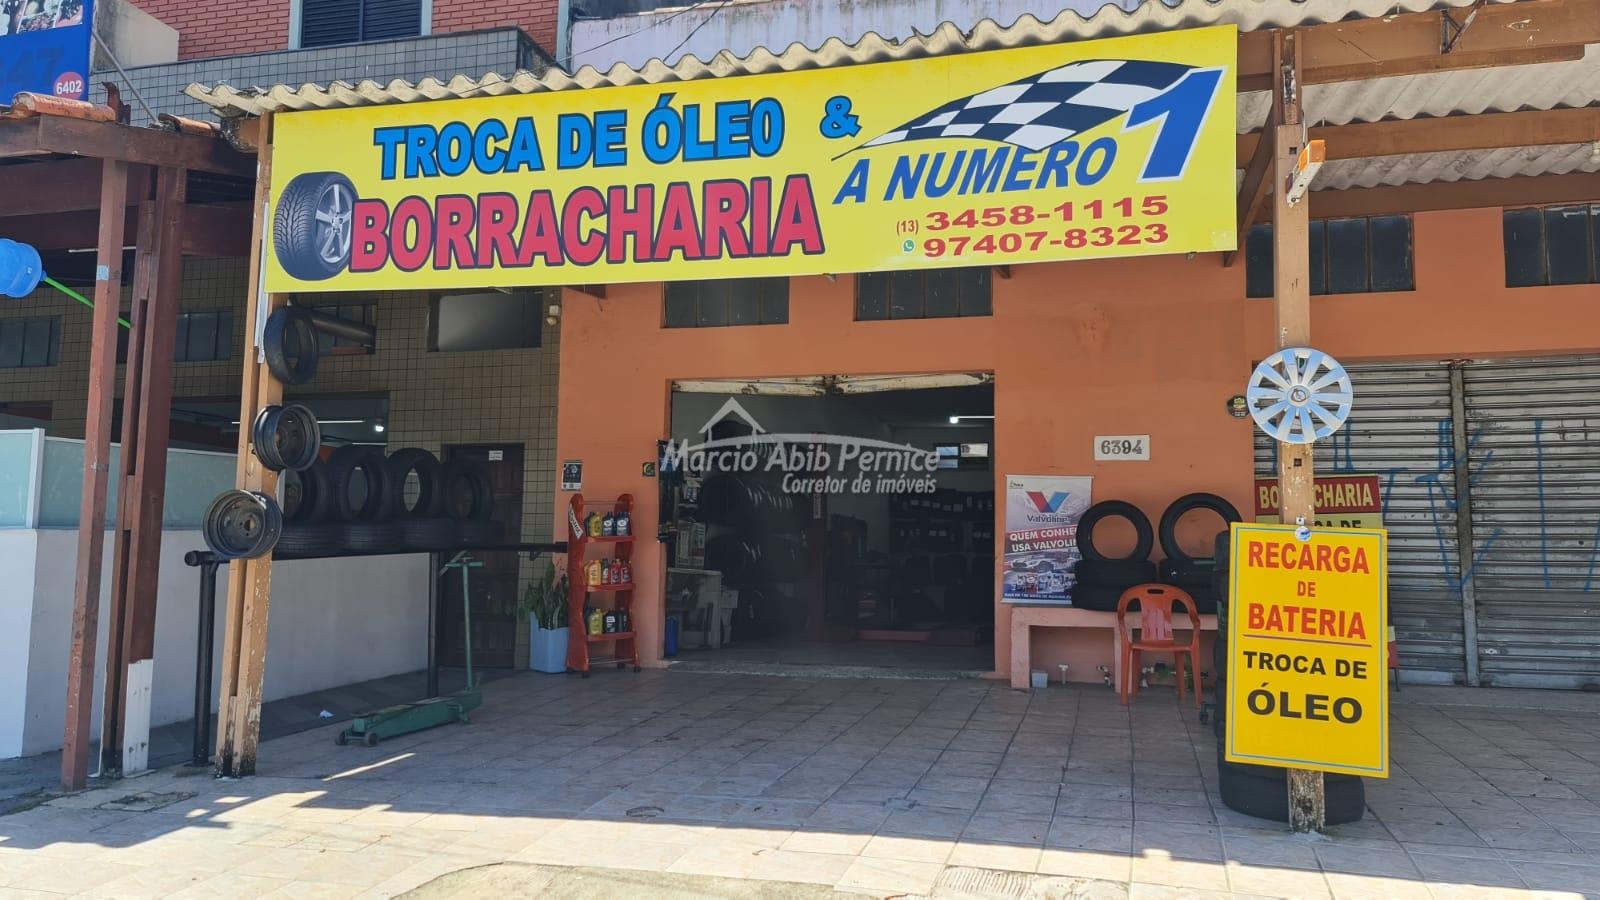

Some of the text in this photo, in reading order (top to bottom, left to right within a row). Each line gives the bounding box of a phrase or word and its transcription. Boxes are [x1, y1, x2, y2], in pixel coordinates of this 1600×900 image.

[56, 79, 82, 95] 6402
[373, 92, 863, 180] TROCA DE ÓLEO &
[831, 66, 1227, 205] A NUMERO 1
[348, 173, 825, 273] BORRACHARIA
[896, 195, 1169, 236] (13) 3458-1115
[923, 223, 1169, 258] 97407-8323
[1101, 439, 1143, 455] 6394
[1260, 483, 1374, 509] BOCHARIA
[1027, 515, 1067, 523] Valvoline
[1009, 532, 1038, 541] QUEM
[1012, 543, 1031, 551] USA
[1248, 541, 1370, 575] RECARGA
[1297, 581, 1316, 597] DE
[1248, 603, 1366, 640] BATERIA
[1243, 651, 1367, 679] TROCA DE
[1247, 682, 1363, 725] ÓLEO
